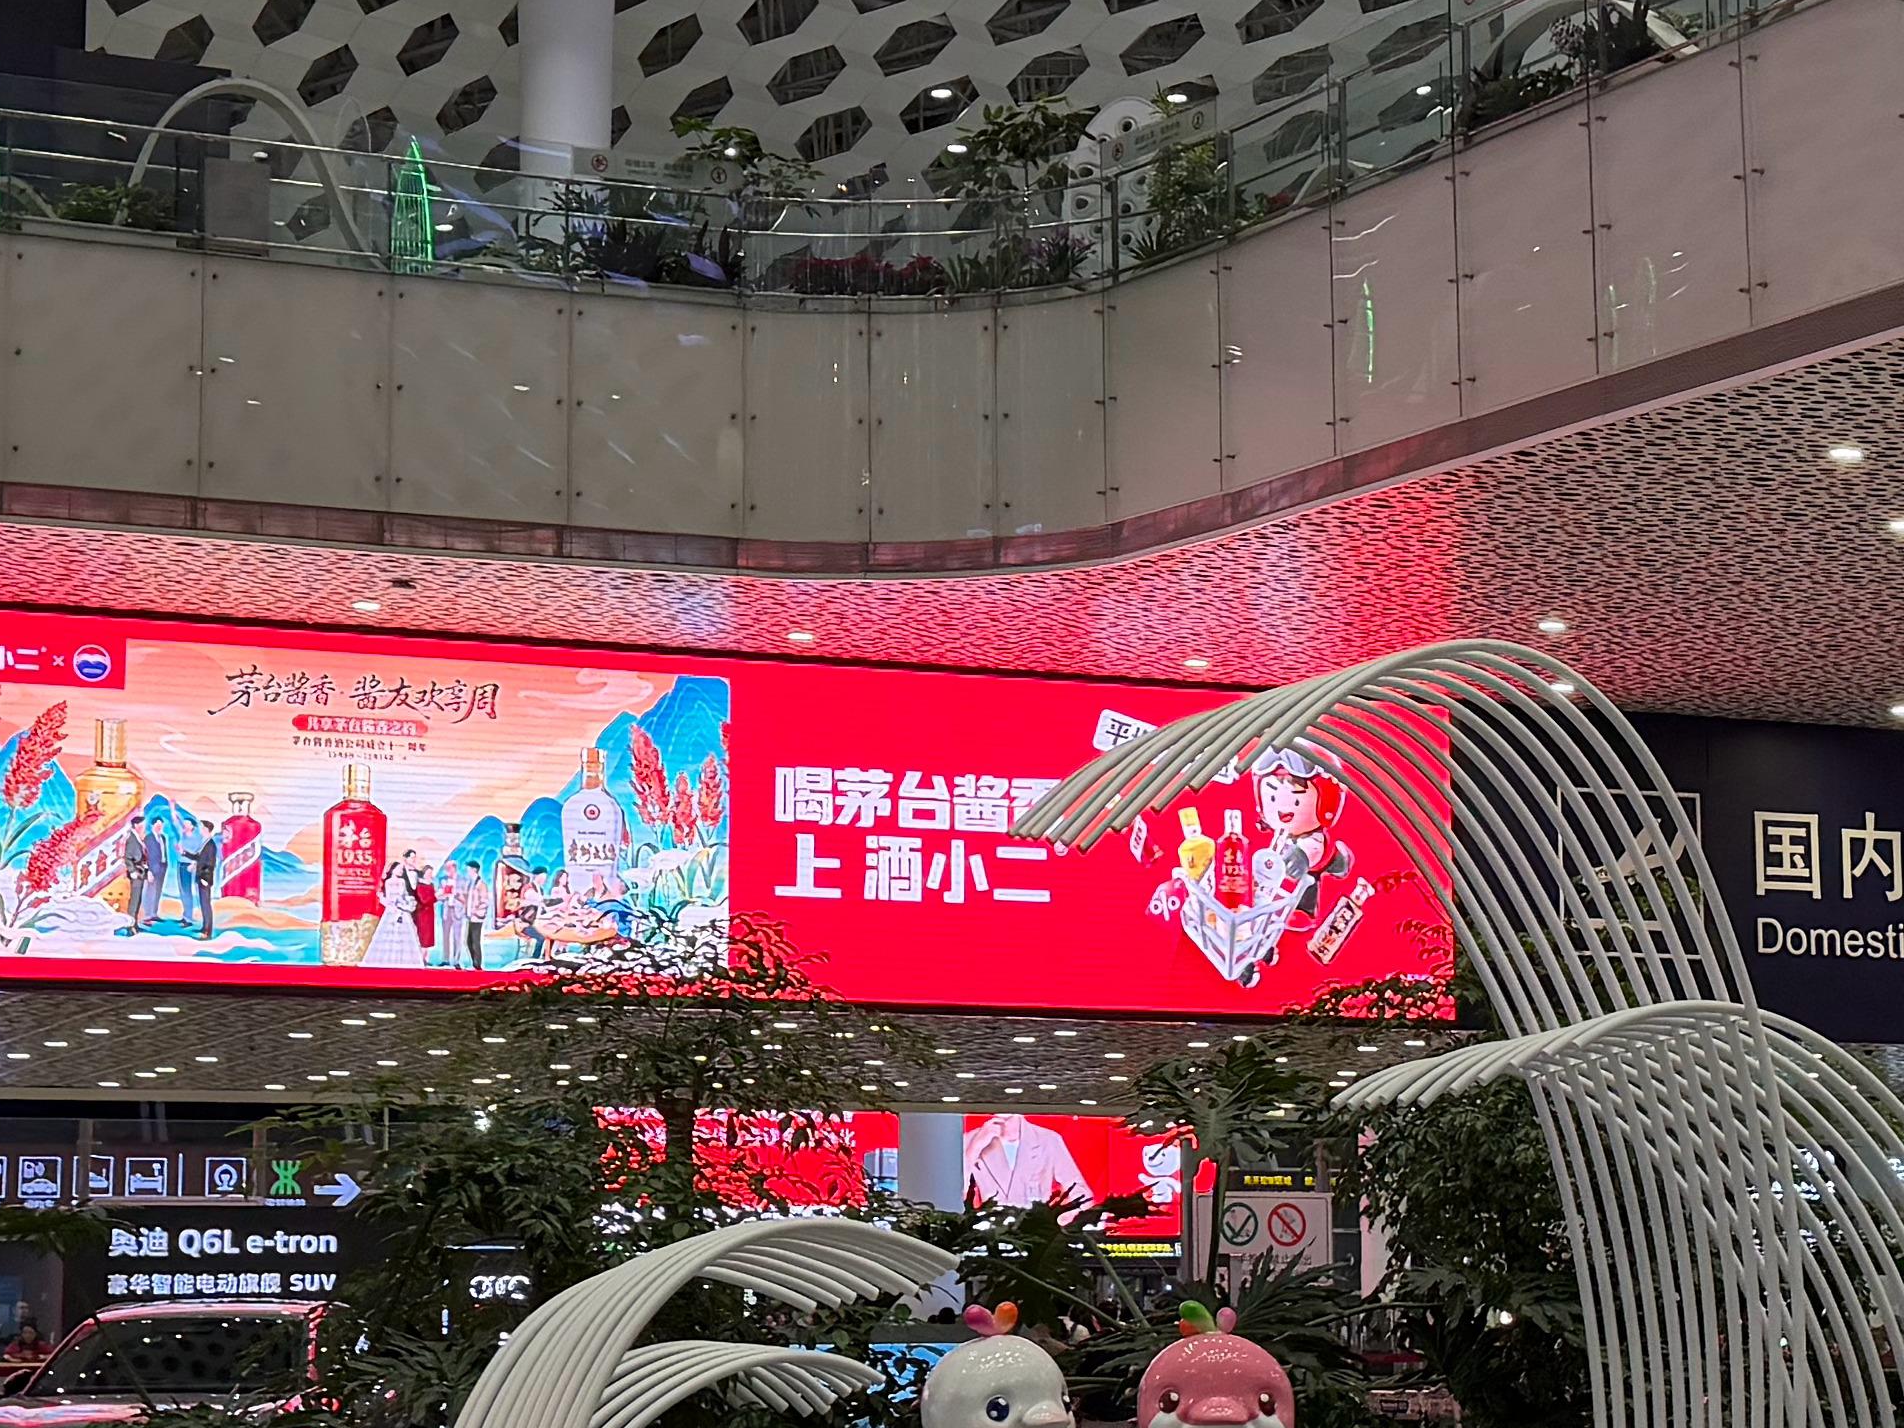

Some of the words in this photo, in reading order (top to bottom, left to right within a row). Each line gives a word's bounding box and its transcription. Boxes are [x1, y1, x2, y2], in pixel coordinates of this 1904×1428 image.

[774, 834, 842, 903] 上
[108, 1227, 169, 1257] 奥迪
[178, 1228, 240, 1258] Q6L
[246, 1230, 338, 1255] e-tron
[107, 1273, 282, 1295] 豪华智能电动旗舰
[289, 1273, 337, 1292] SUV
